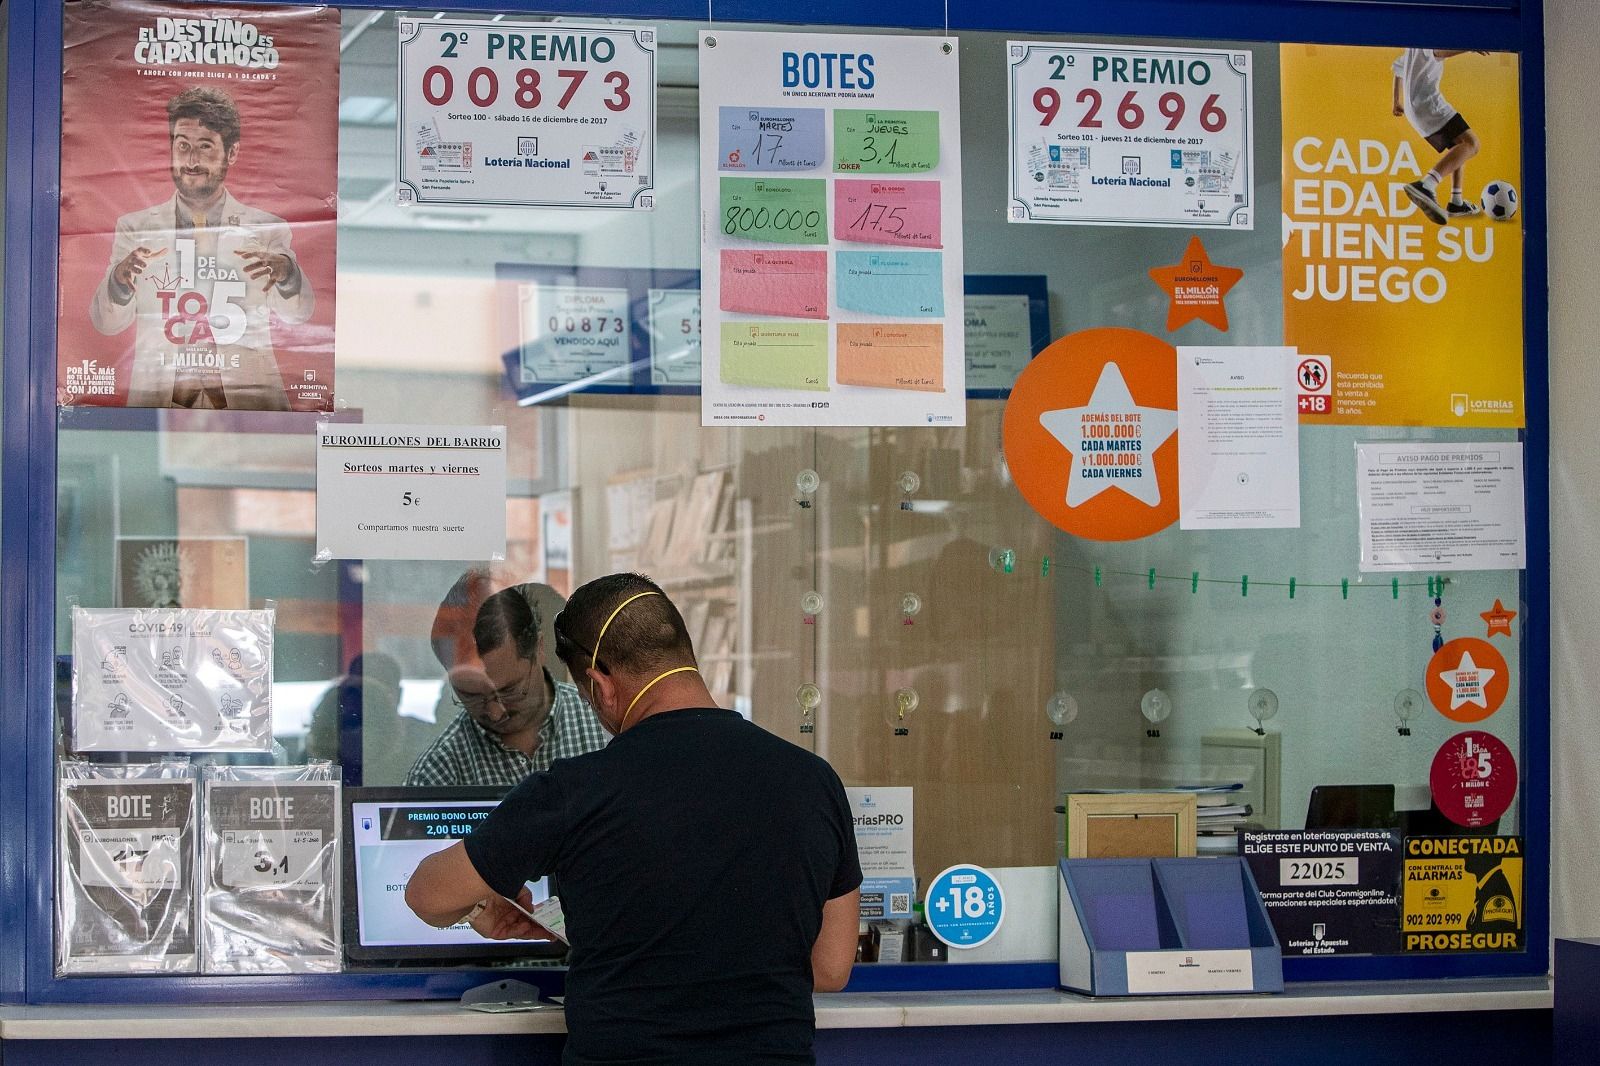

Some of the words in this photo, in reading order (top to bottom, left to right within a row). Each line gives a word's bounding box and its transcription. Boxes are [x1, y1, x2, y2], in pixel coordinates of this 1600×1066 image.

[138, 27, 157, 42] EL
[156, 17, 258, 47] DESTINO
[258, 34, 274, 48] ES
[440, 32, 468, 58] 2º
[487, 33, 616, 64] PREMIO
[134, 41, 279, 70] CAPRICHOSO
[782, 52, 875, 90] BOTES
[1048, 54, 1075, 80] 2º
[1093, 56, 1211, 86] PREMIO
[422, 65, 632, 112] 00873
[1032, 87, 1226, 132] 92696
[448, 112, 472, 120] Sorteo
[494, 114, 520, 122] sábado
[543, 116, 578, 124] diciembre
[760, 122, 793, 132] MARTES
[867, 125, 909, 135] JUEVES
[1101, 135, 1122, 143] jueves
[1144, 136, 1176, 144] diciembre
[752, 134, 783, 166] 17
[1292, 136, 1422, 176] CADA
[484, 156, 522, 167] Lotería
[524, 158, 570, 168] Nacional
[1092, 176, 1127, 186] Lotería
[1129, 178, 1170, 188] Nacional
[1294, 180, 1419, 218] EDAD
[726, 206, 820, 234] 800.000
[1291, 222, 1424, 260] TIENE
[1436, 226, 1494, 262] SU
[176, 239, 195, 288] 1
[198, 256, 216, 268] DE
[198, 267, 239, 281] CADA
[1175, 286, 1185, 294] EL
[1186, 284, 1218, 294] MILLÓN
[1292, 264, 1447, 304] JUEGO
[212, 281, 246, 345] 5
[550, 316, 624, 333] 00873
[554, 338, 595, 346] VENDIDO
[597, 338, 620, 347] AQUÍ
[160, 352, 165, 366] 1
[173, 350, 225, 368] MILLÓN
[230, 354, 240, 368] €
[66, 366, 82, 374] POR
[98, 366, 115, 375] MÁS
[66, 386, 84, 394] CON
[87, 386, 115, 394] JOKER
[1299, 397, 1326, 411] +18
[1470, 400, 1514, 408] LOTERÍAS
[1082, 412, 1110, 422] ADEMÁS
[1110, 414, 1123, 422] DEL
[1125, 414, 1141, 422] BOTE
[322, 436, 421, 446] EUROMILLONES
[427, 437, 452, 447] DEL
[454, 438, 501, 448] BARRIO
[1082, 440, 1104, 451] CADA
[1106, 440, 1142, 451] MARTES
[344, 462, 383, 473] Sorteos
[389, 464, 424, 473] martes
[431, 466, 436, 475] y
[443, 464, 479, 474] viernes
[1082, 468, 1104, 478] CADA
[1106, 468, 1142, 478] VIERNES
[358, 523, 408, 533] Compartamos
[129, 623, 183, 633] COVID-19
[1464, 737, 1472, 757] 1
[1478, 753, 1492, 778] 5
[107, 795, 152, 817] BOTE
[250, 797, 294, 819] BOTE
[426, 825, 449, 835] 2,00
[451, 825, 472, 834] EUR
[1303, 832, 1391, 842] loteriasyapuestas.es
[1244, 844, 1273, 854] ELIGE
[1275, 844, 1300, 853] ESTE
[1303, 843, 1338, 852] PUNTO
[1340, 843, 1354, 852] DE
[1409, 838, 1519, 855] CONECTADA
[1290, 863, 1345, 880] 22025
[1408, 871, 1462, 881] ALARMAS
[987, 886, 995, 916] AÑOS
[1283, 891, 1304, 900] parte
[1336, 889, 1384, 899] Conmigonline
[936, 886, 986, 918] +18
[1309, 898, 1346, 908] especiales
[1407, 914, 1423, 925] 902
[1426, 914, 1442, 925] 202
[1445, 914, 1461, 924] 999
[1407, 933, 1517, 950] PROSEGUR
